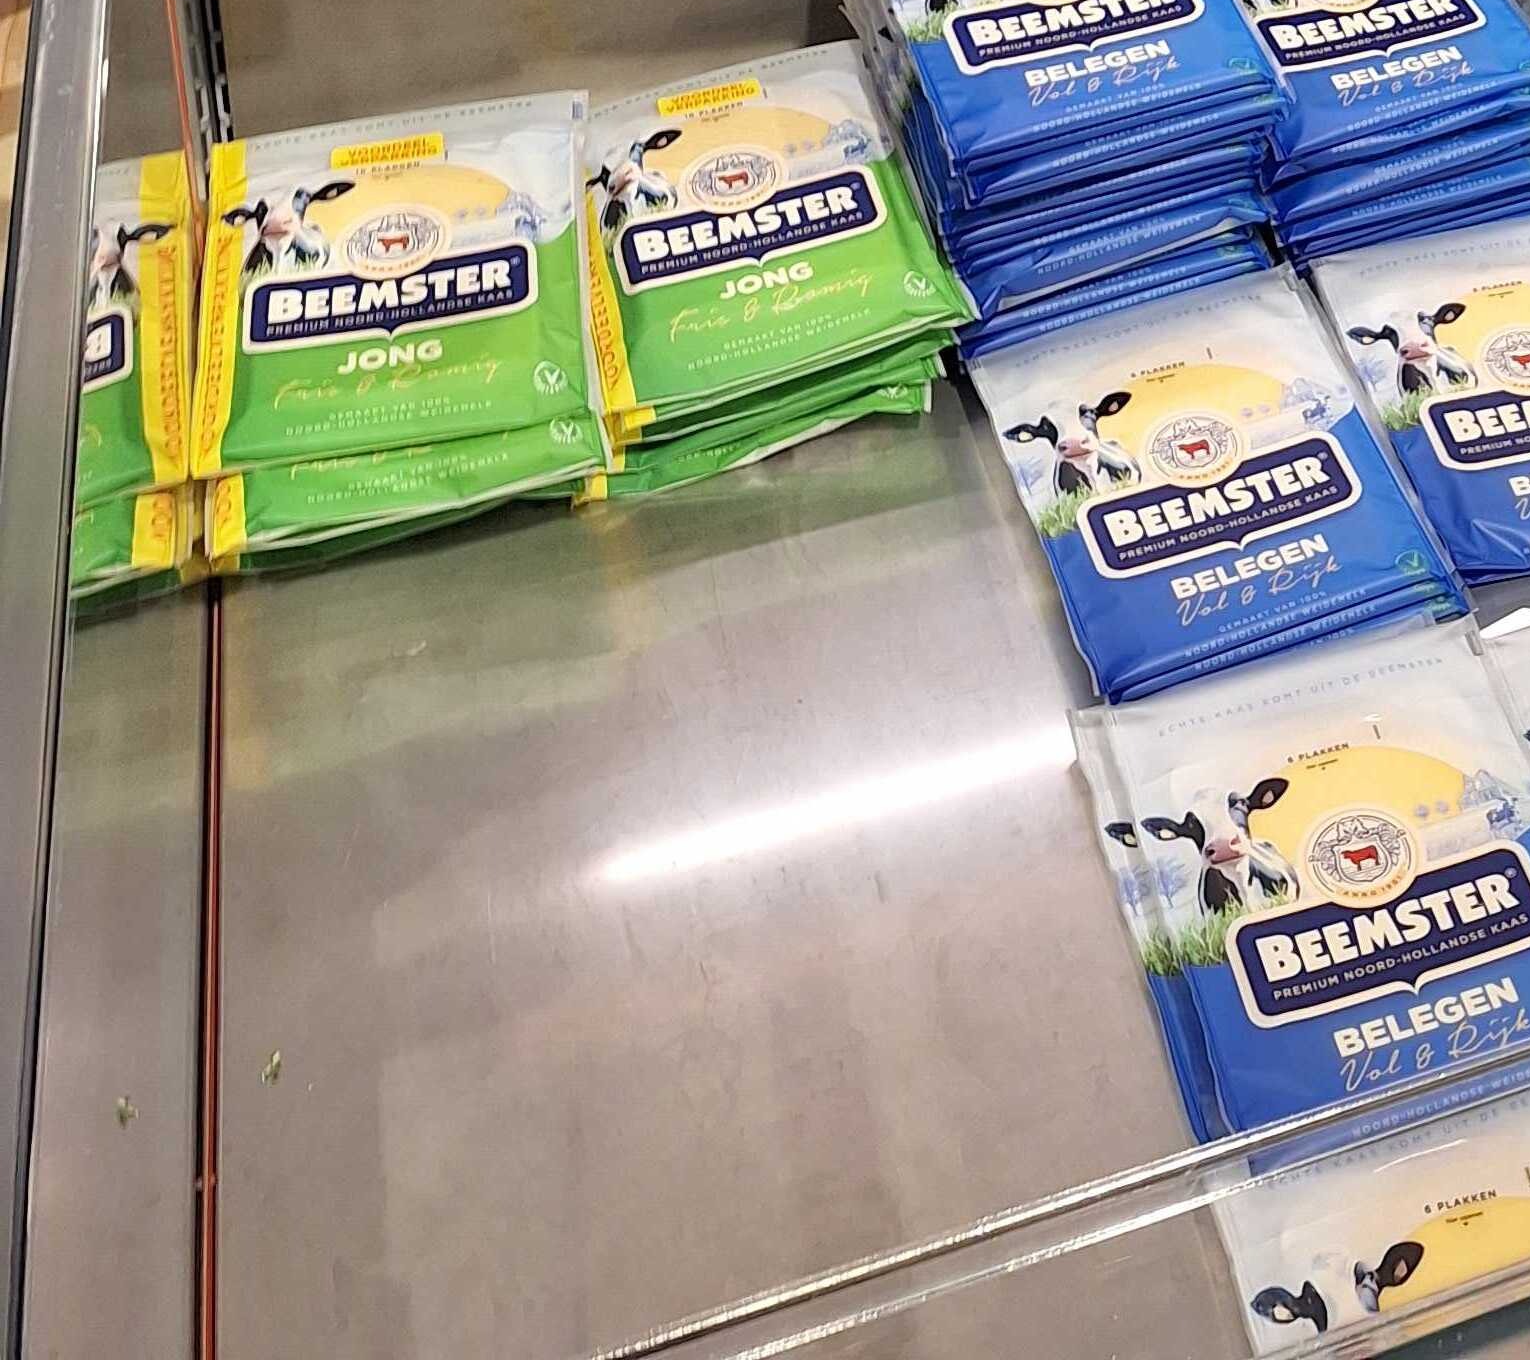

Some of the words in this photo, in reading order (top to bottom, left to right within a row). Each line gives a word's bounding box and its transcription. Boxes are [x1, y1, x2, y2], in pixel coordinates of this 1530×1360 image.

[1024, 39, 1172, 89] BELEGEN
[1330, 45, 1465, 93] BELEGEN
[633, 186, 858, 264] BEEMSTER
[267, 259, 512, 326] BEEMSTER
[719, 261, 814, 300] JONG
[337, 338, 443, 376] JONG
[1102, 456, 1331, 548] BEEMSTER
[1169, 533, 1330, 600] BELEGEN
[1254, 873, 1520, 984] BEEMSTER
[1273, 975, 1340, 1001] PREMIUM
[1343, 928, 1487, 982] NOORD-HOLLANDSE
[1490, 913, 1530, 936] KAAS
[1332, 976, 1519, 1058] BELEGEN
[1423, 1205, 1432, 1214] 6
[1437, 1189, 1498, 1212] PLAKKEN
